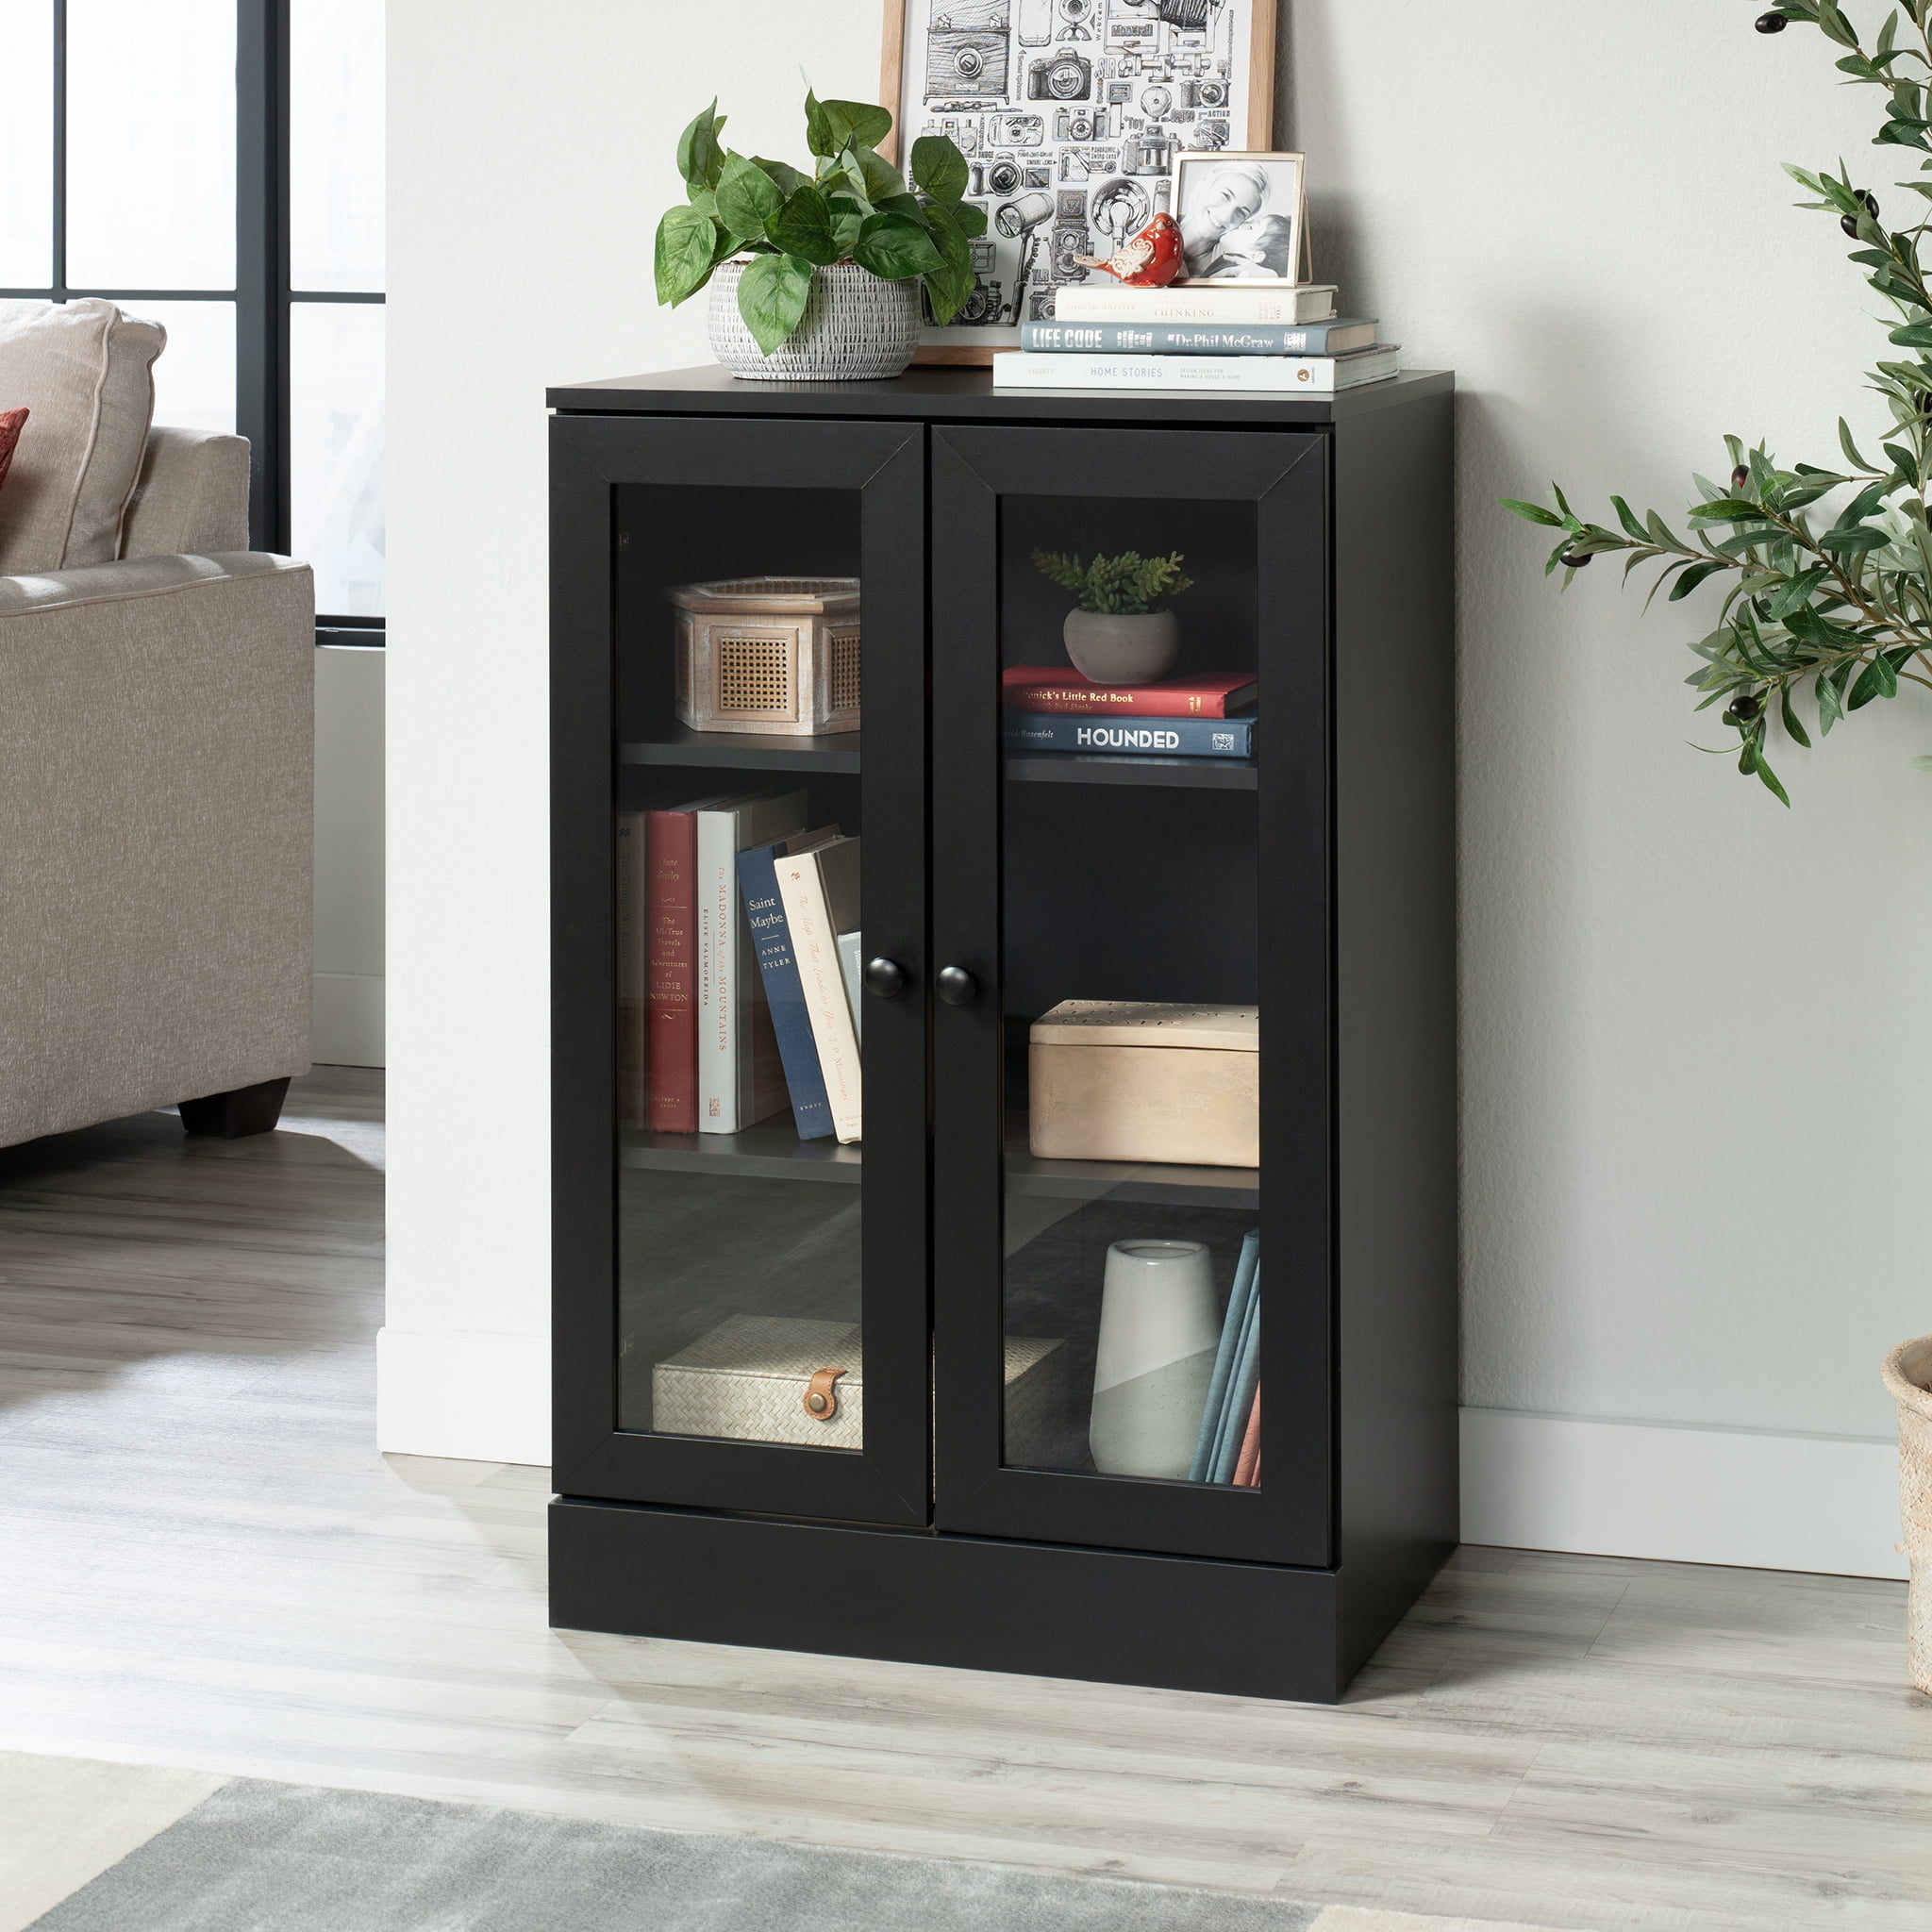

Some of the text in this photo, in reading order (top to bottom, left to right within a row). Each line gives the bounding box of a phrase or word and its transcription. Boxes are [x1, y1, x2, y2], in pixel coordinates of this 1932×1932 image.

[1032, 269, 1049, 281] TLR
[1033, 328, 1061, 348] LIFE
[1064, 329, 1103, 348] CODE
[1222, 335, 1274, 348] McGraw
[1091, 367, 1163, 378] HOME STORIES
[1062, 691, 1087, 701] Little
[1090, 692, 1108, 702] Red
[1110, 693, 1133, 703] Book
[1021, 729, 1055, 740] Rosenfelt
[1077, 728, 1179, 749] HOUNDED
[749, 898, 775, 911] Saint
[662, 916, 675, 924] The
[751, 913, 784, 929] Maybe
[761, 945, 787, 956] ANNE
[763, 958, 791, 969] TYLER
[651, 992, 688, 1002] NEWTON
